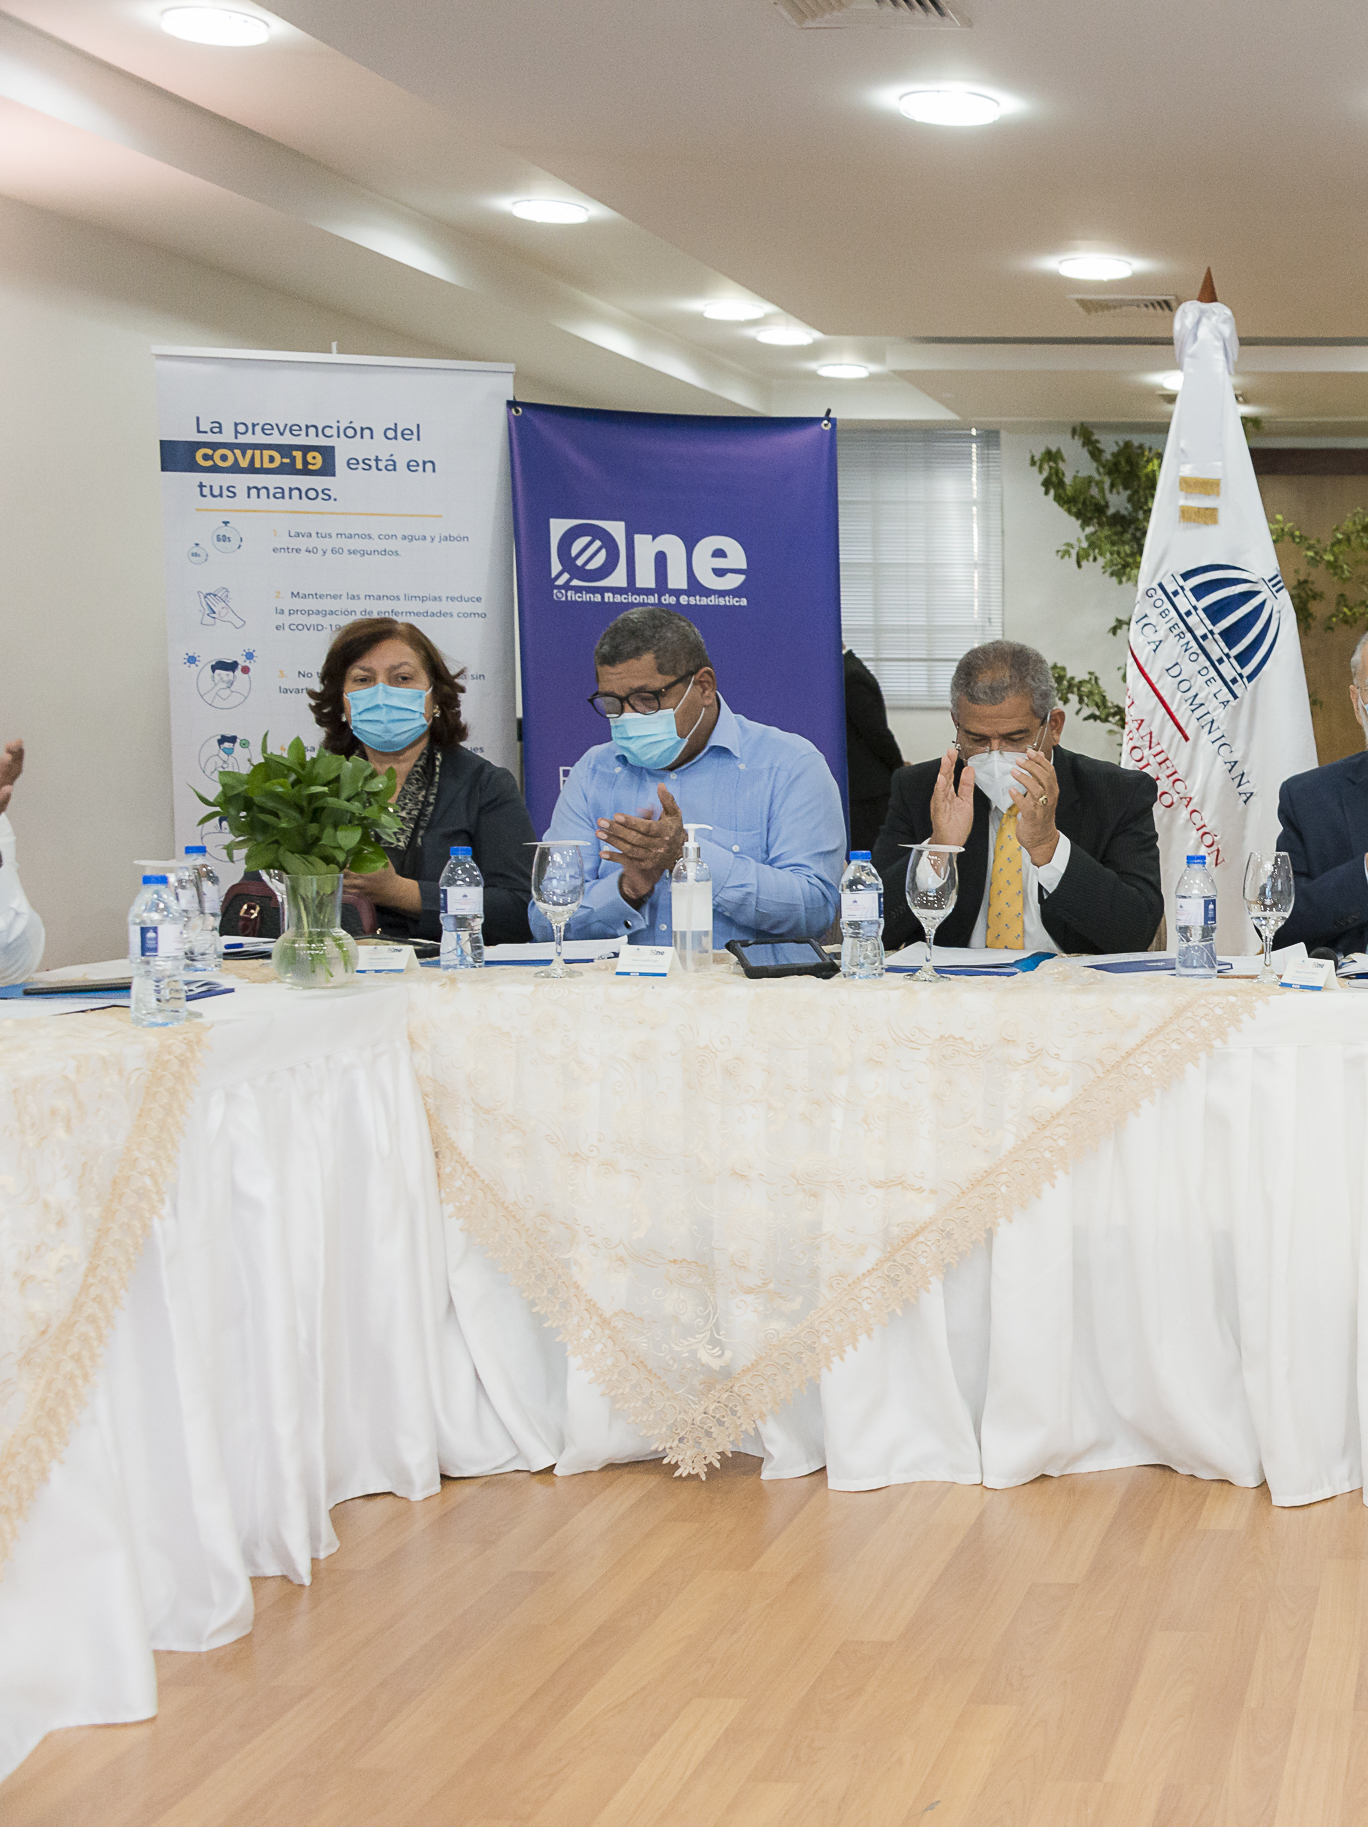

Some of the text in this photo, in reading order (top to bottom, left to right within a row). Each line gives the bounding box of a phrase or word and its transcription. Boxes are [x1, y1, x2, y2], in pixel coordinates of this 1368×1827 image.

[196, 416, 421, 441] La prevención del
[195, 447, 436, 473] COVID-19 está en
[197, 481, 338, 502] tus manos.
[288, 530, 312, 539] Lava
[316, 531, 332, 539] tus
[378, 533, 397, 541] con
[401, 534, 427, 543] agua
[430, 535, 436, 543] y
[437, 533, 470, 543] jabón
[272, 547, 302, 555] entre
[305, 546, 319, 555] 40
[321, 549, 327, 557] y
[330, 547, 345, 556] 60
[290, 592, 343, 601] Mantener
[346, 592, 361, 601] las
[404, 593, 443, 604] limpias
[445, 594, 482, 603] reduce
[661, 593, 677, 604] de
[275, 607, 487, 619] la propagación de enfermedades como
[275, 623, 285, 631] el
[1146, 587, 1231, 710] GOBIERNO DE LA
[470, 672, 486, 680] sin
[1165, 662, 1254, 805] DOMINICANA
